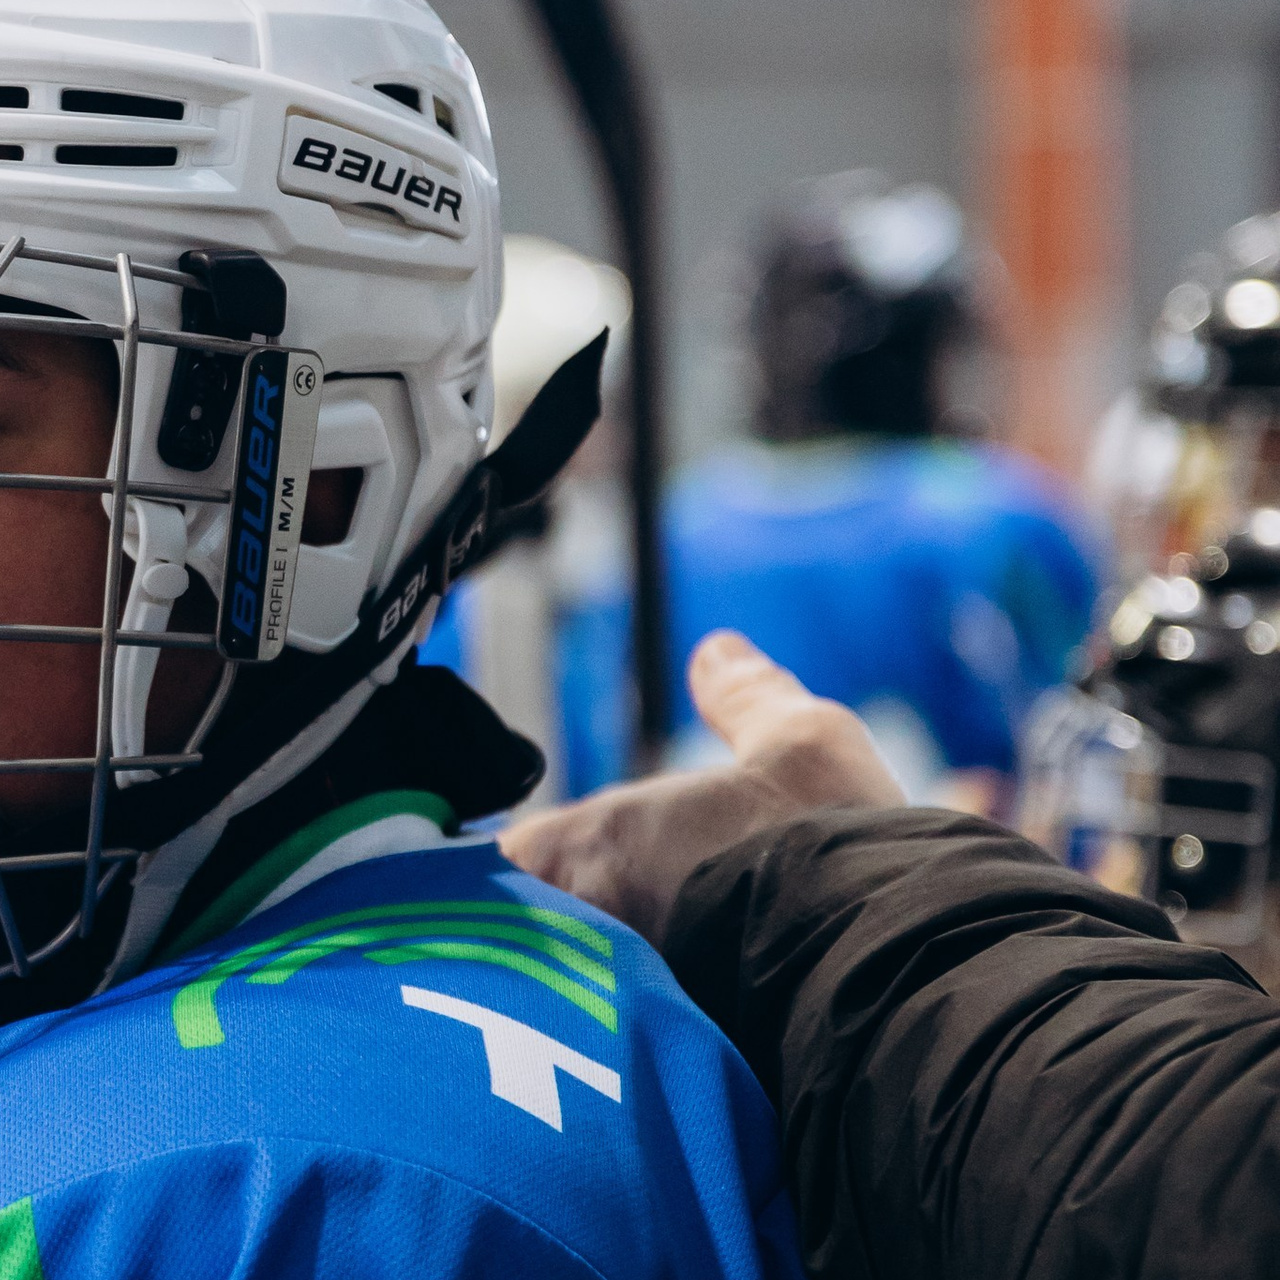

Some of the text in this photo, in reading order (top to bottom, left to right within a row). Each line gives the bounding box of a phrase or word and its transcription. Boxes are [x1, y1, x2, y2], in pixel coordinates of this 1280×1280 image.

[292, 136, 463, 223] BAUER
[231, 373, 280, 638] BAUER
[276, 476, 296, 532] M/M
[266, 559, 287, 642] PROFILE
